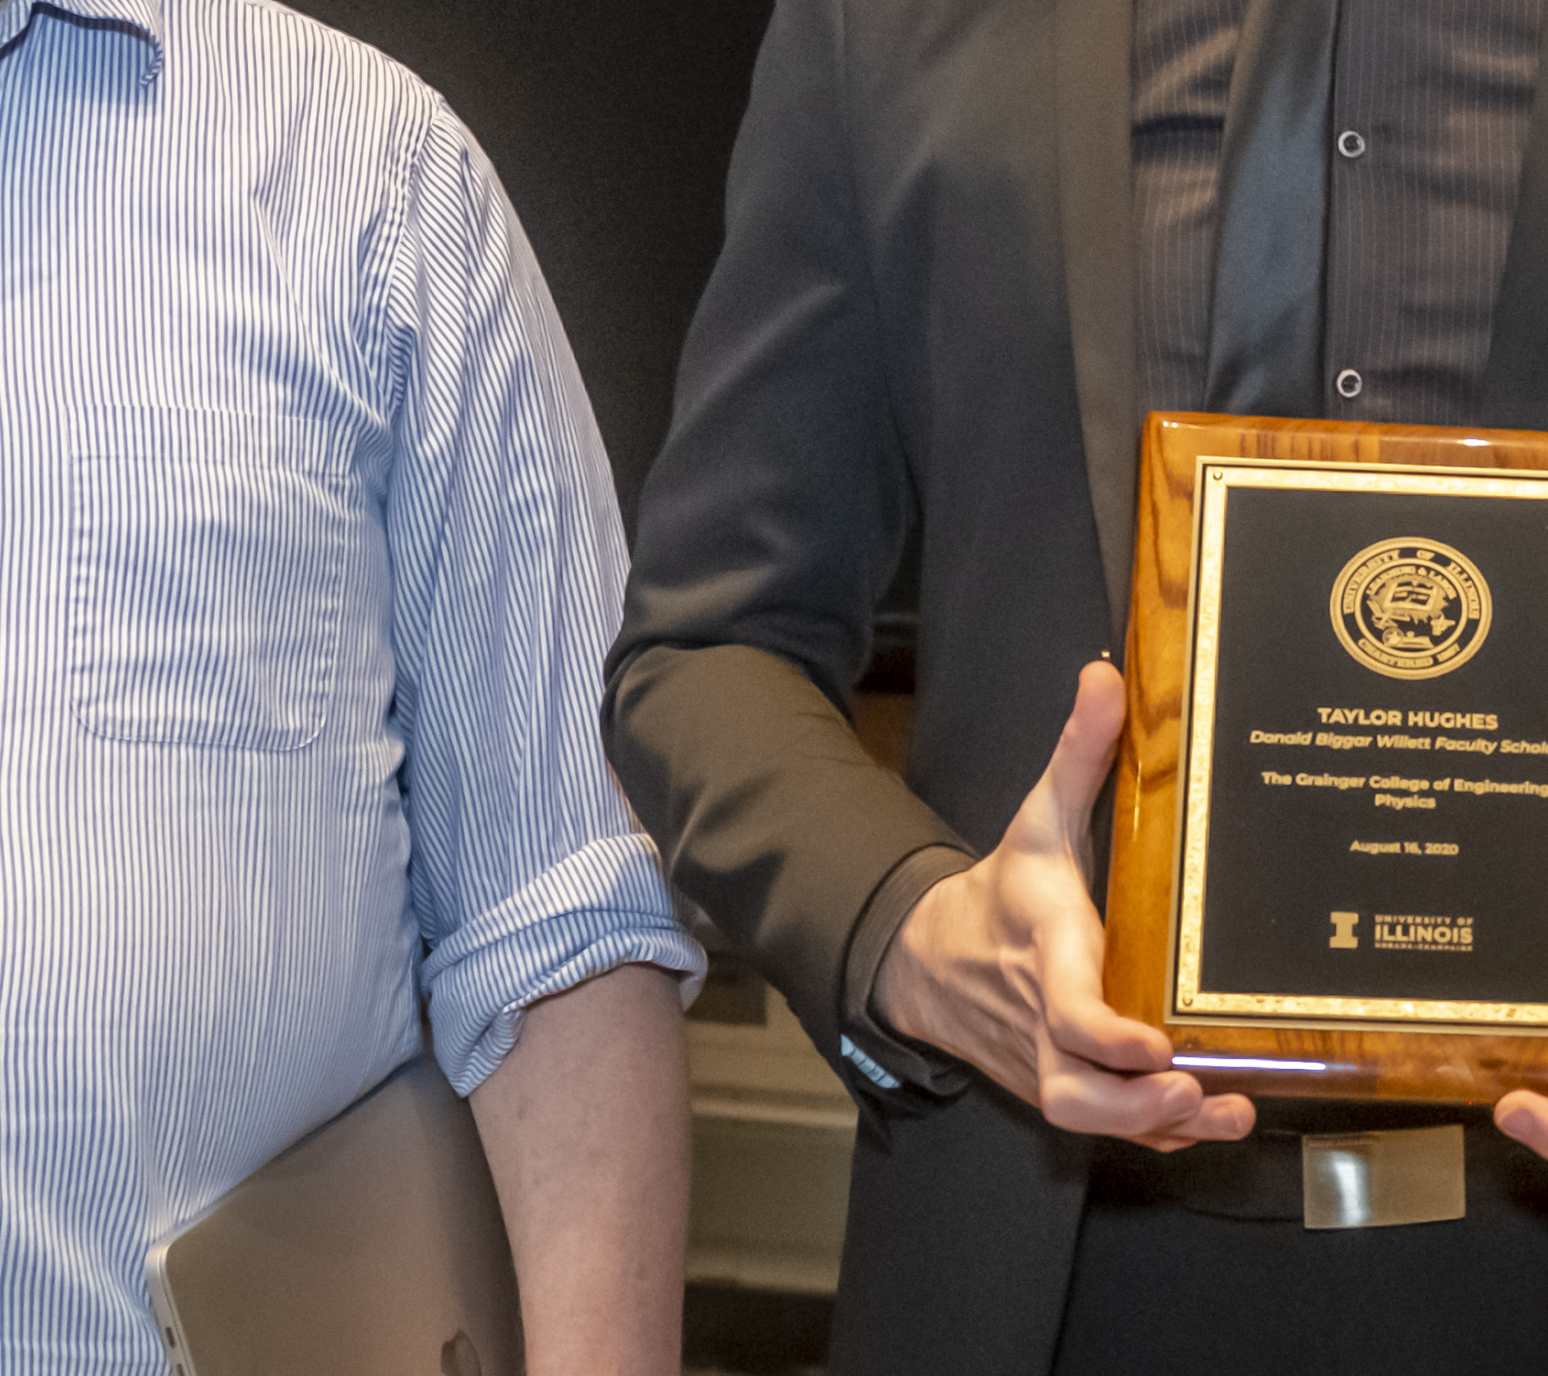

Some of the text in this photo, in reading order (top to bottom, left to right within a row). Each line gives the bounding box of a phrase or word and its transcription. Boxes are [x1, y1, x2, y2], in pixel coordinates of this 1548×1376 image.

[1317, 707, 1500, 731] TAYLOR HUGHES
[1250, 730, 1313, 745] Donald
[1315, 731, 1373, 750] Biggar
[1377, 734, 1431, 750] Willett
[1435, 736, 1498, 755] Faculty
[1261, 771, 1293, 786] The
[1295, 772, 1366, 790] Grainger
[1369, 775, 1430, 792] College
[1432, 777, 1451, 791] of
[1374, 793, 1437, 810] Physics
[1350, 839, 1401, 855] August
[1424, 842, 1460, 855] 2020
[1374, 914, 1451, 924] UNIVERSITY
[1374, 923, 1474, 944] ILLINOIS
